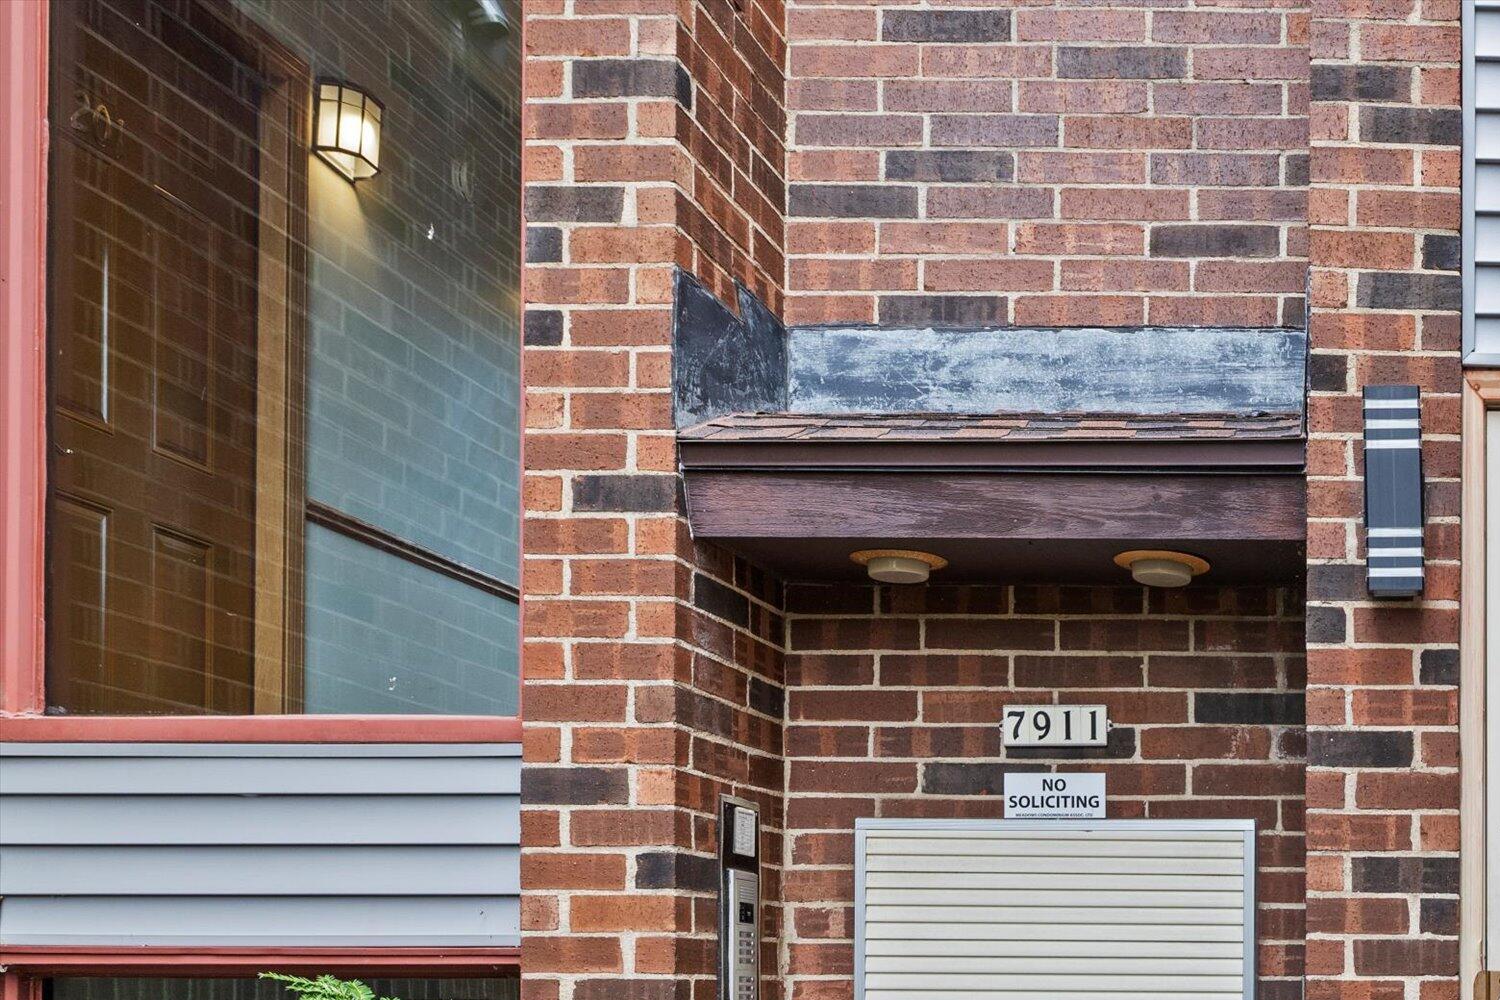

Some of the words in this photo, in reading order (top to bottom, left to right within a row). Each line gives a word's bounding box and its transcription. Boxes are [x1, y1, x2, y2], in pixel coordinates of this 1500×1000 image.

[1007, 710, 1098, 741] 7911
[1042, 778, 1067, 792] NO
[1008, 795, 1100, 809] SOLICITING
